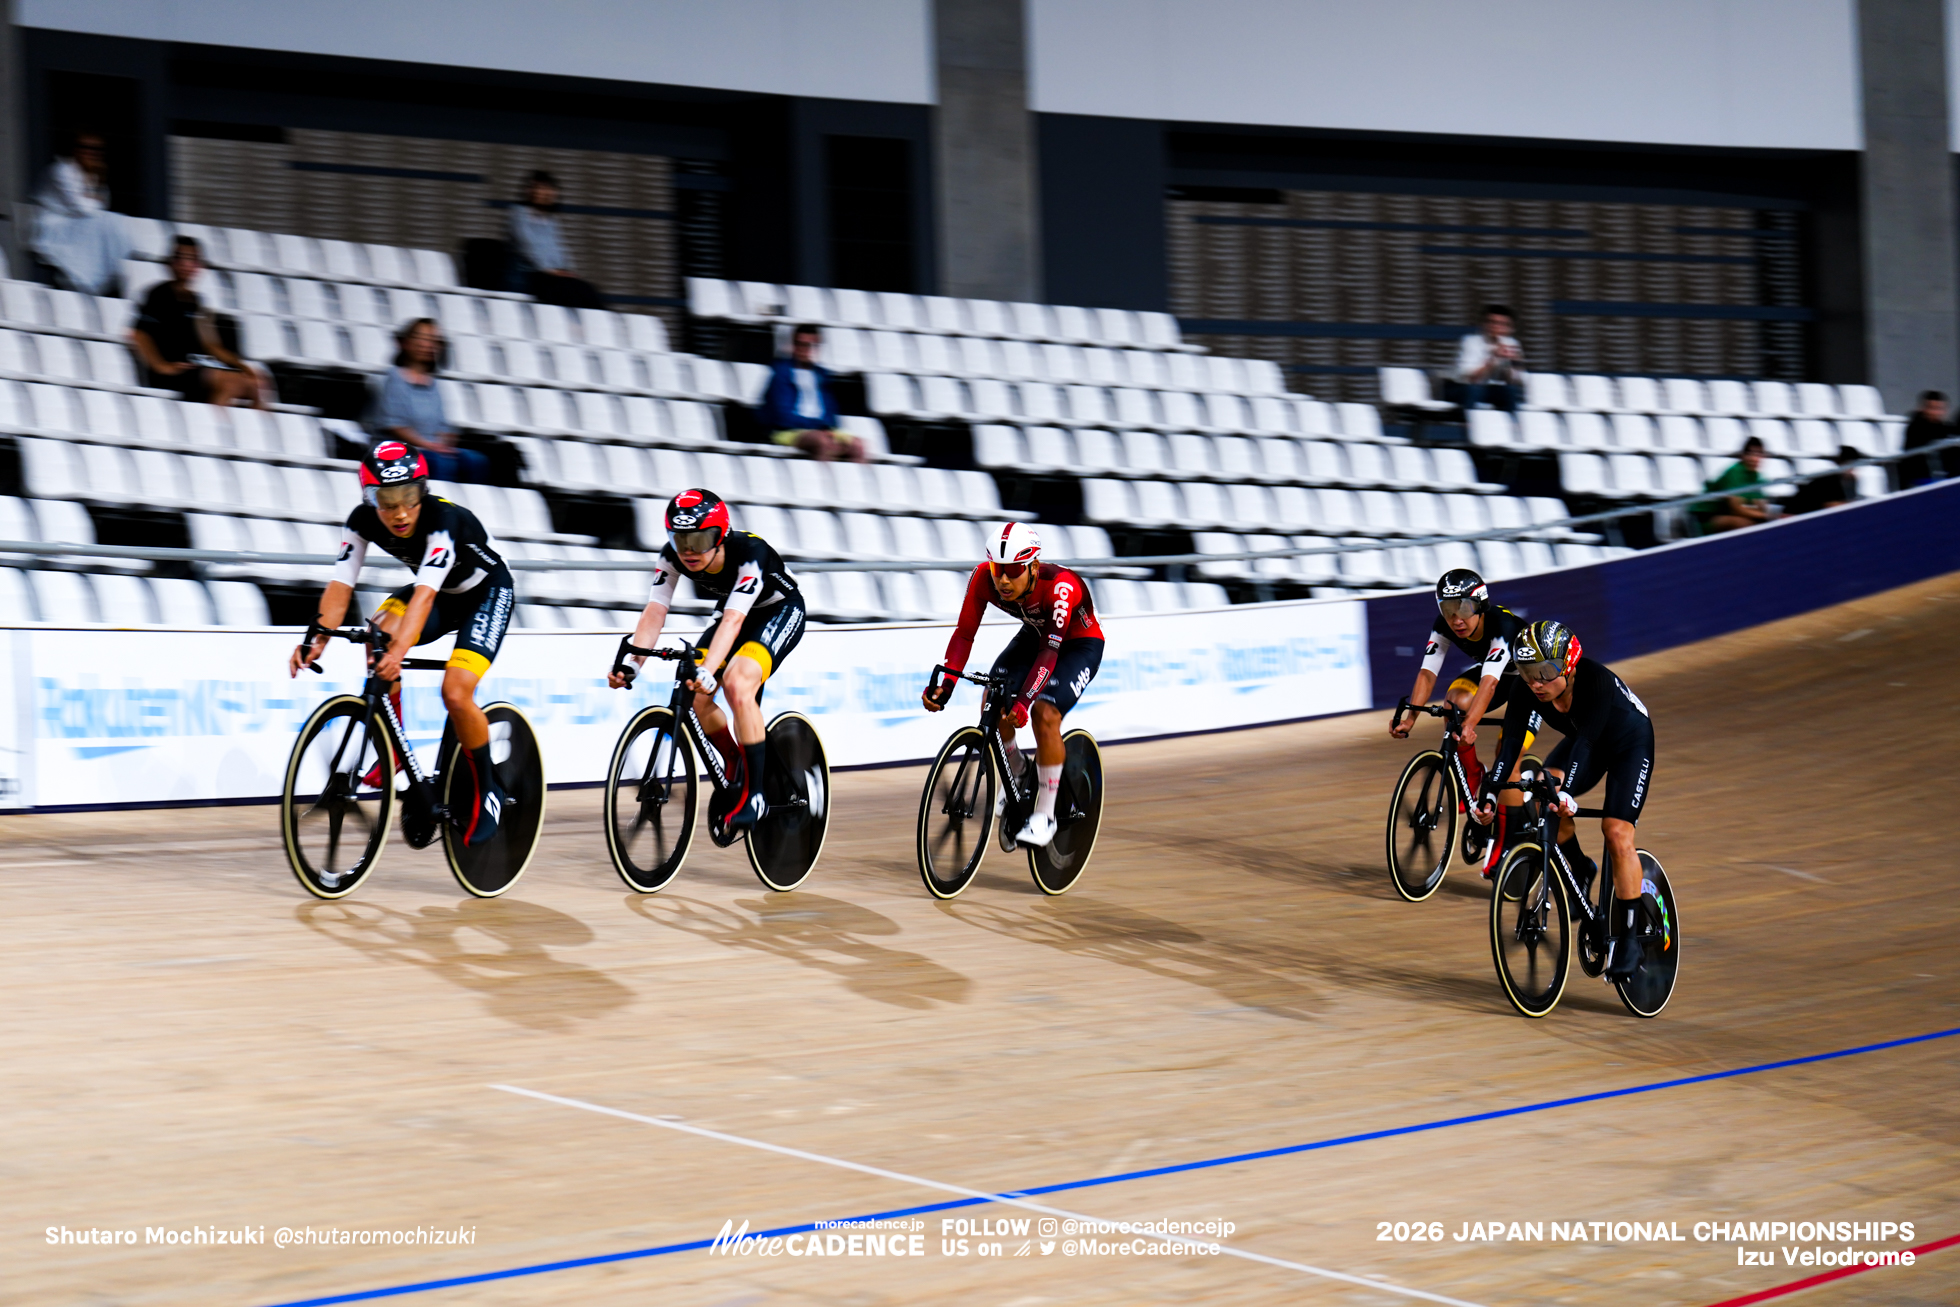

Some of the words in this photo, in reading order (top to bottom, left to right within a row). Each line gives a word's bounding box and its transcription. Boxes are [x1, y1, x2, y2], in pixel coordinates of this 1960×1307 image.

[688, 707, 730, 789] BRIDGESTONE
[995, 728, 1022, 803] BRIDGESTONE
[1493, 761, 1504, 782] CASTE
[1565, 761, 1579, 789] CASTELLI
[1453, 751, 1474, 808] BRIDGESTO
[1632, 757, 1650, 809] CASTELLI
[1554, 842, 1595, 921] BRIDGESTONE
